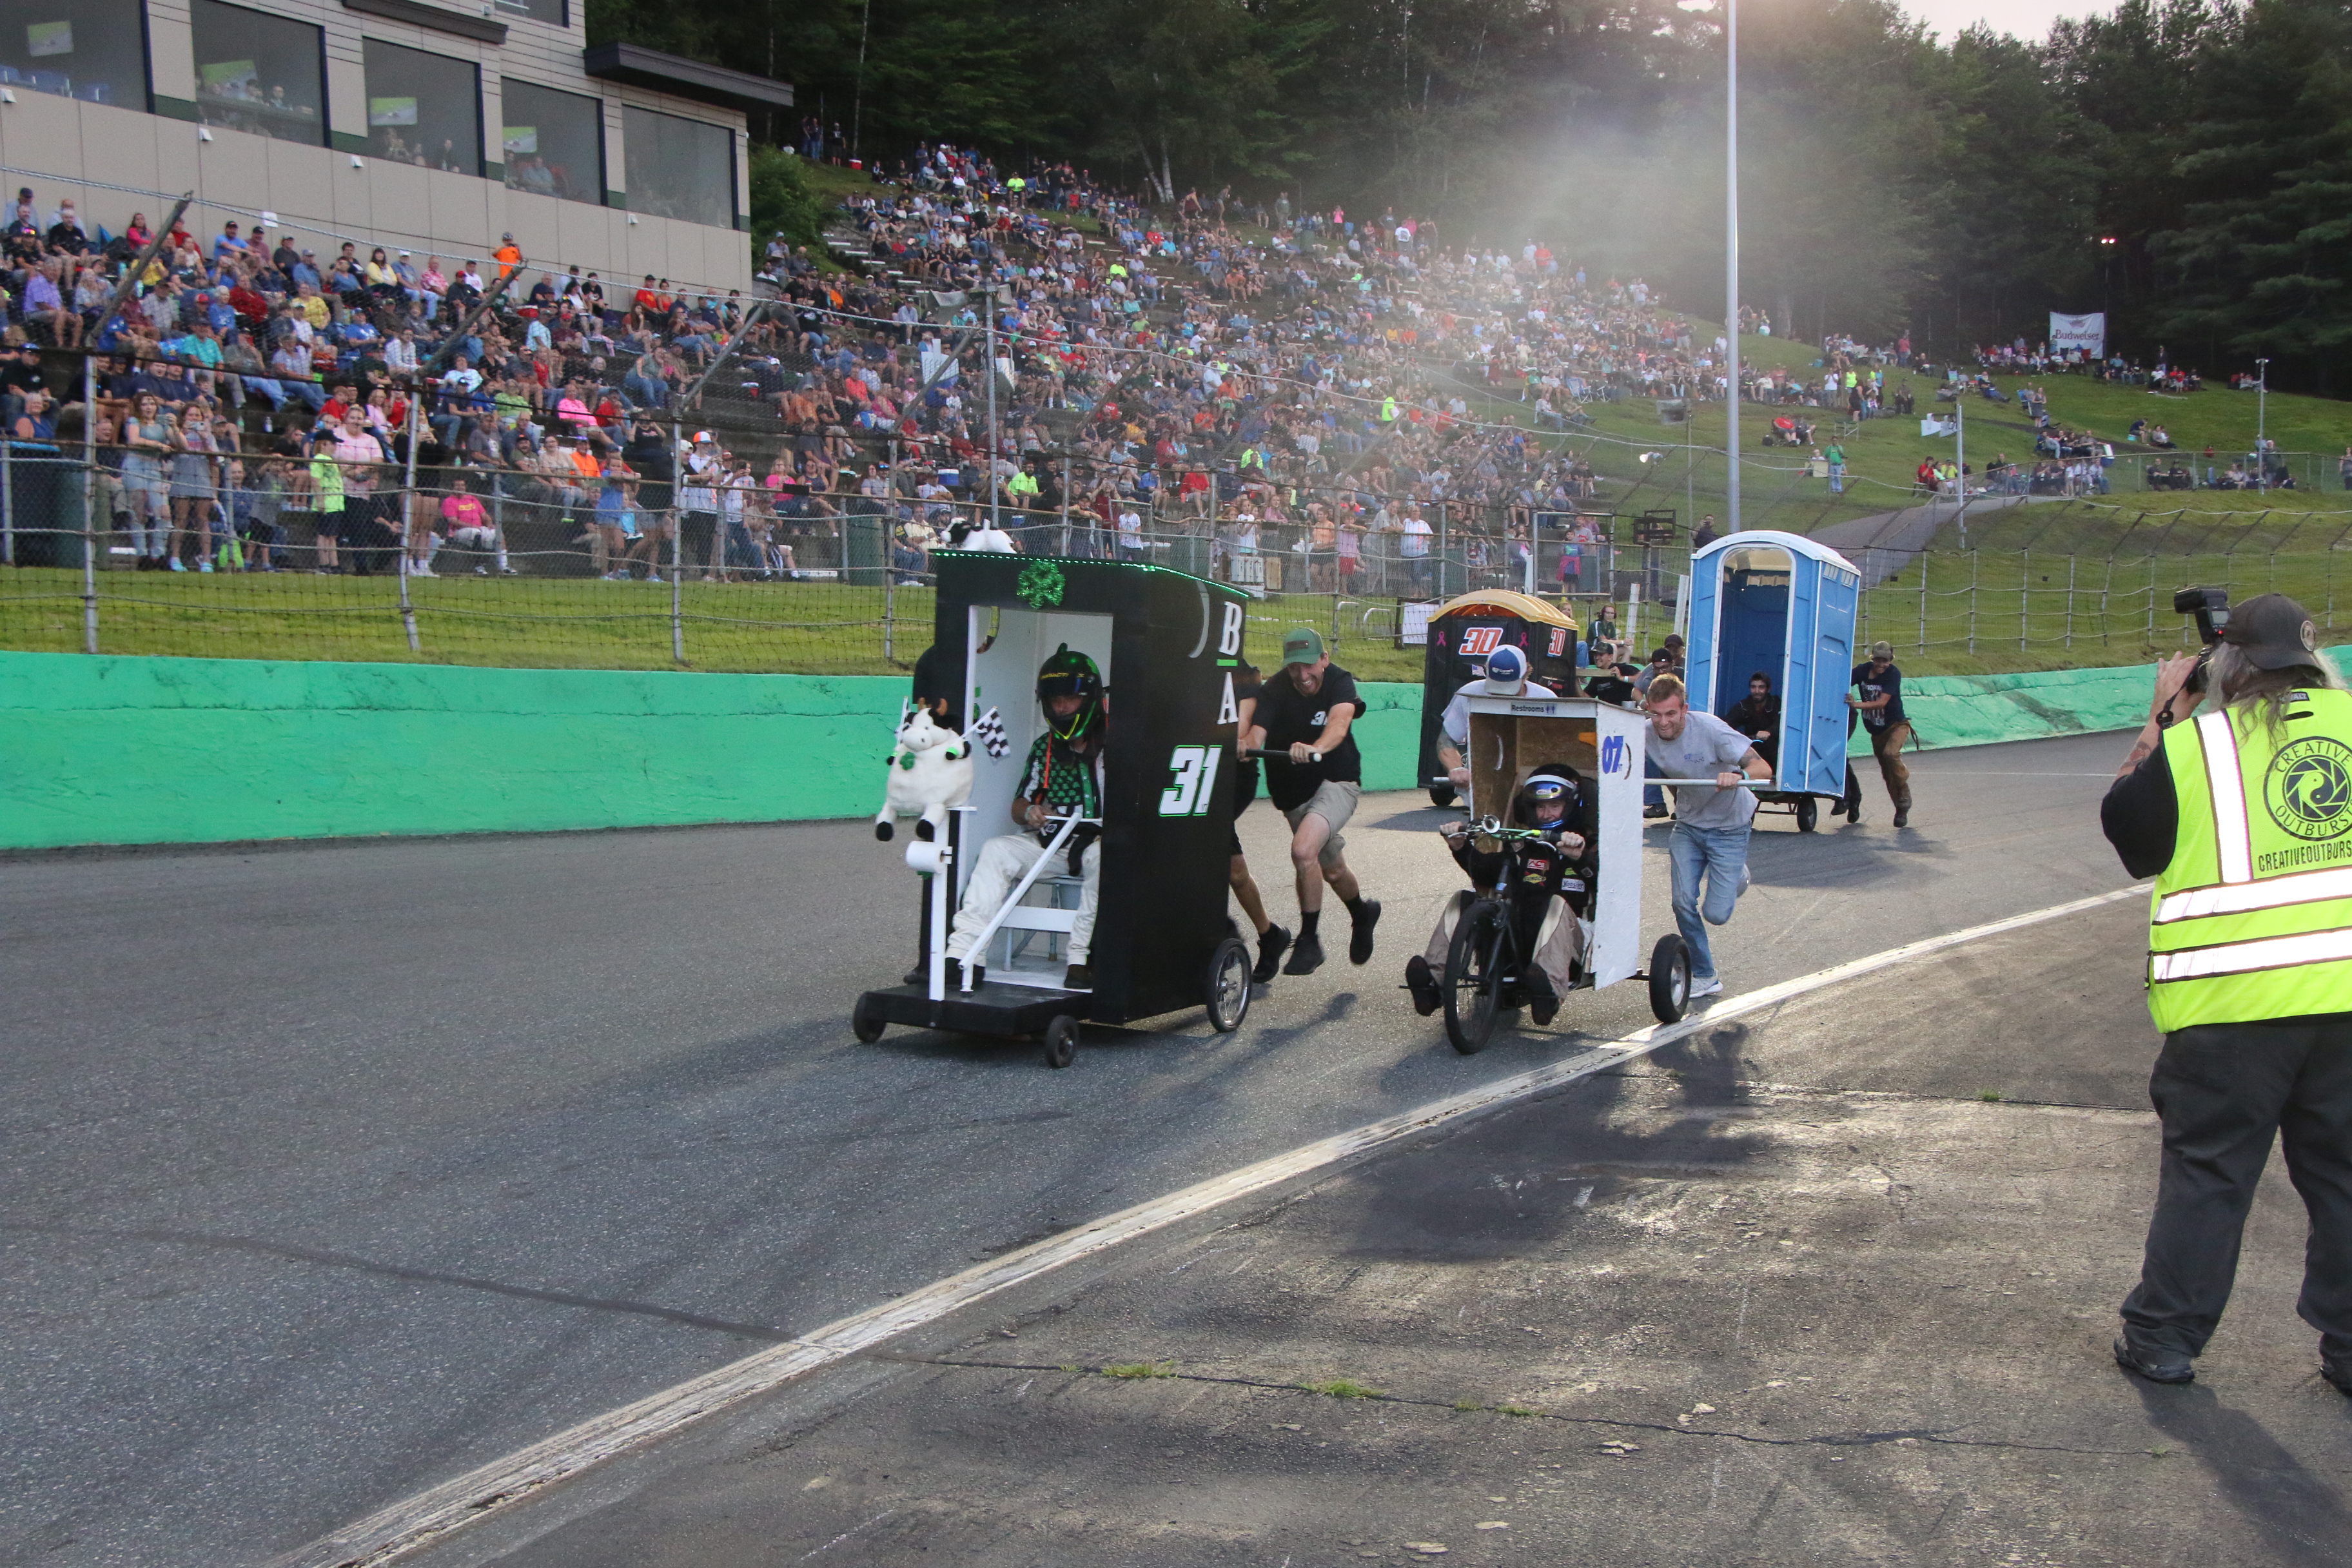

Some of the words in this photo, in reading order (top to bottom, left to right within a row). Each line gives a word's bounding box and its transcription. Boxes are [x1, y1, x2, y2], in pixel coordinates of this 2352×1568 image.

[2055, 329, 2099, 340] Budweiser
[1458, 627, 1504, 656] 30
[1548, 627, 1566, 656] 30
[1602, 736, 1624, 774] 07
[2275, 741, 2352, 773] CREATIVE
[1159, 745, 1222, 817] 31
